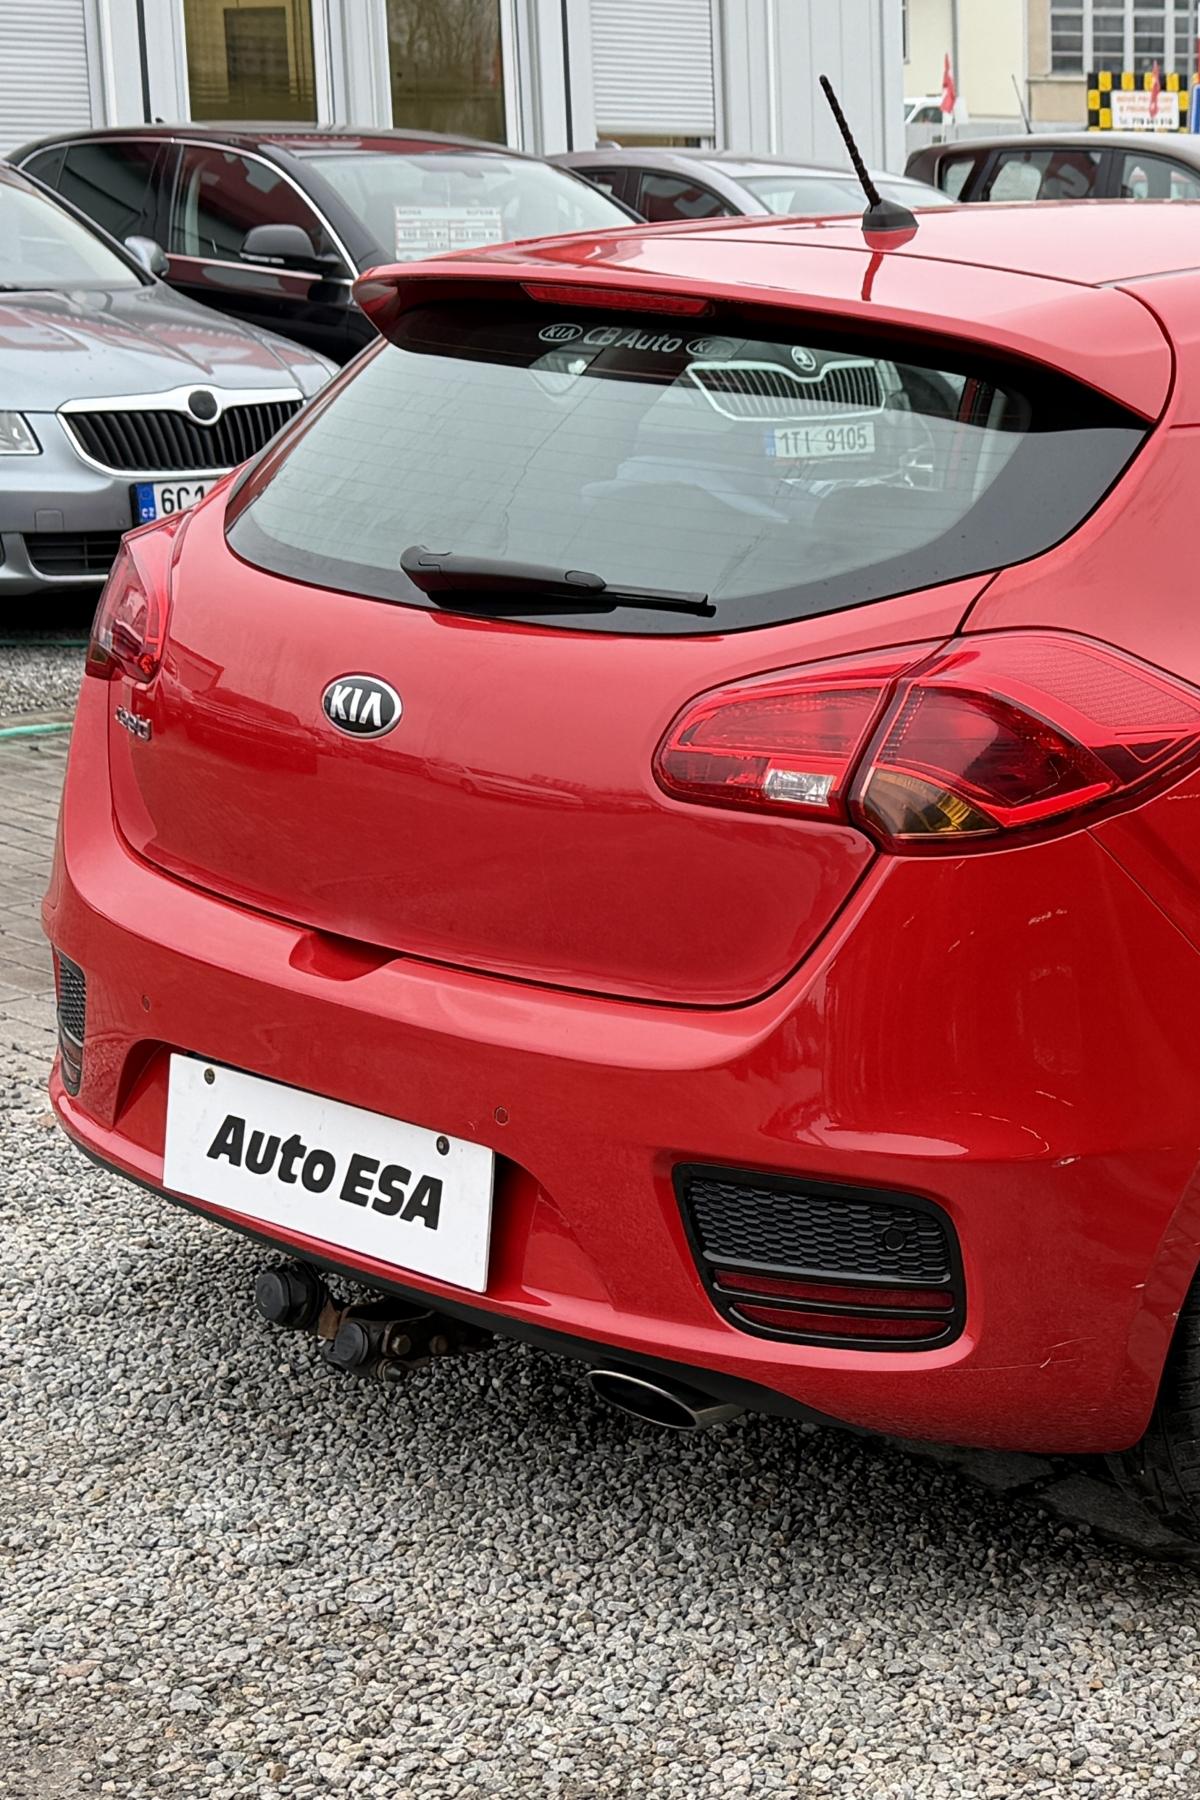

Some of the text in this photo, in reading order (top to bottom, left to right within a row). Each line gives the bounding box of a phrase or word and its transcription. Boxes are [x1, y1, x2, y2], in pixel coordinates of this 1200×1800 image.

[614, 329, 682, 352] Auto
[780, 426, 868, 456] 1TI 9105
[141, 507, 155, 518] CZ
[329, 684, 383, 727] KIA
[206, 1114, 444, 1231] Auto ESA
